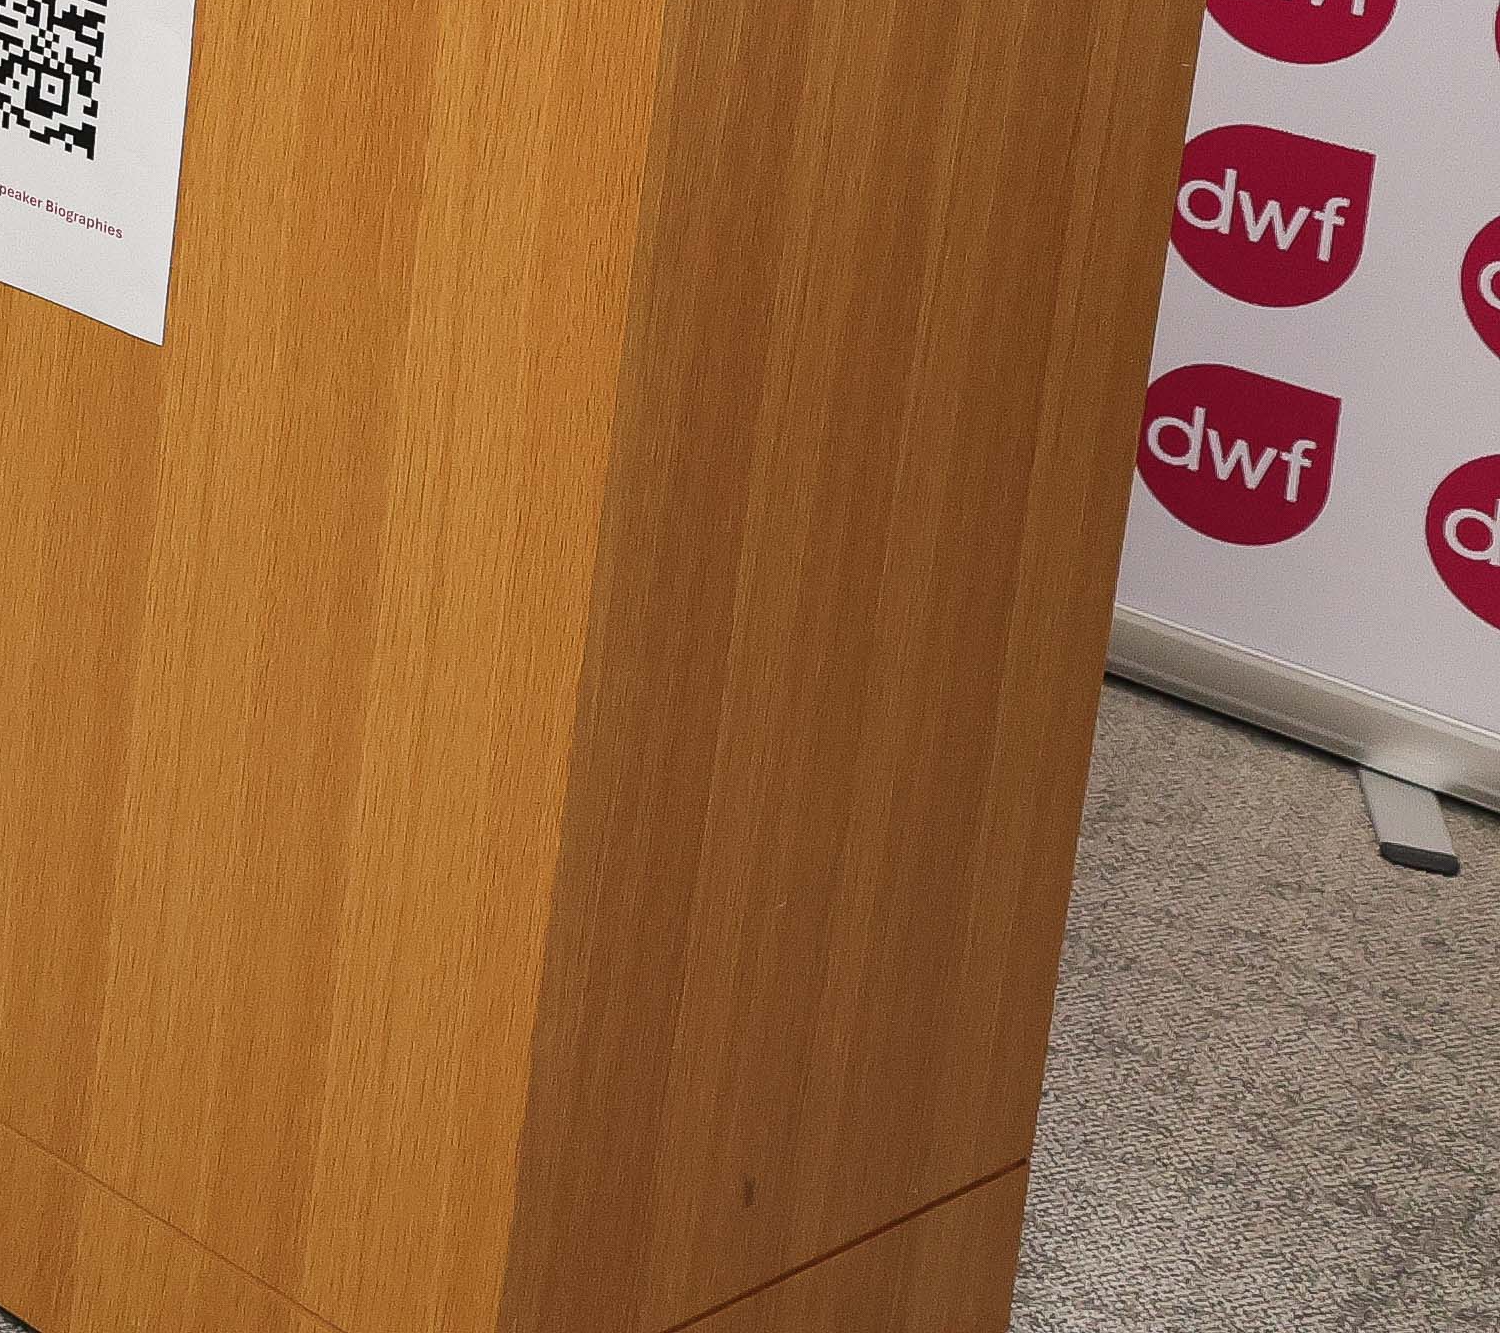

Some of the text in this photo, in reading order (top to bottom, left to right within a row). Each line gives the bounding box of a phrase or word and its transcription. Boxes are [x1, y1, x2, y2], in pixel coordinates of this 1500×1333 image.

[45, 200, 123, 239] Biographies
[1177, 167, 1351, 262] dwf
[1147, 404, 1318, 503] dwf
